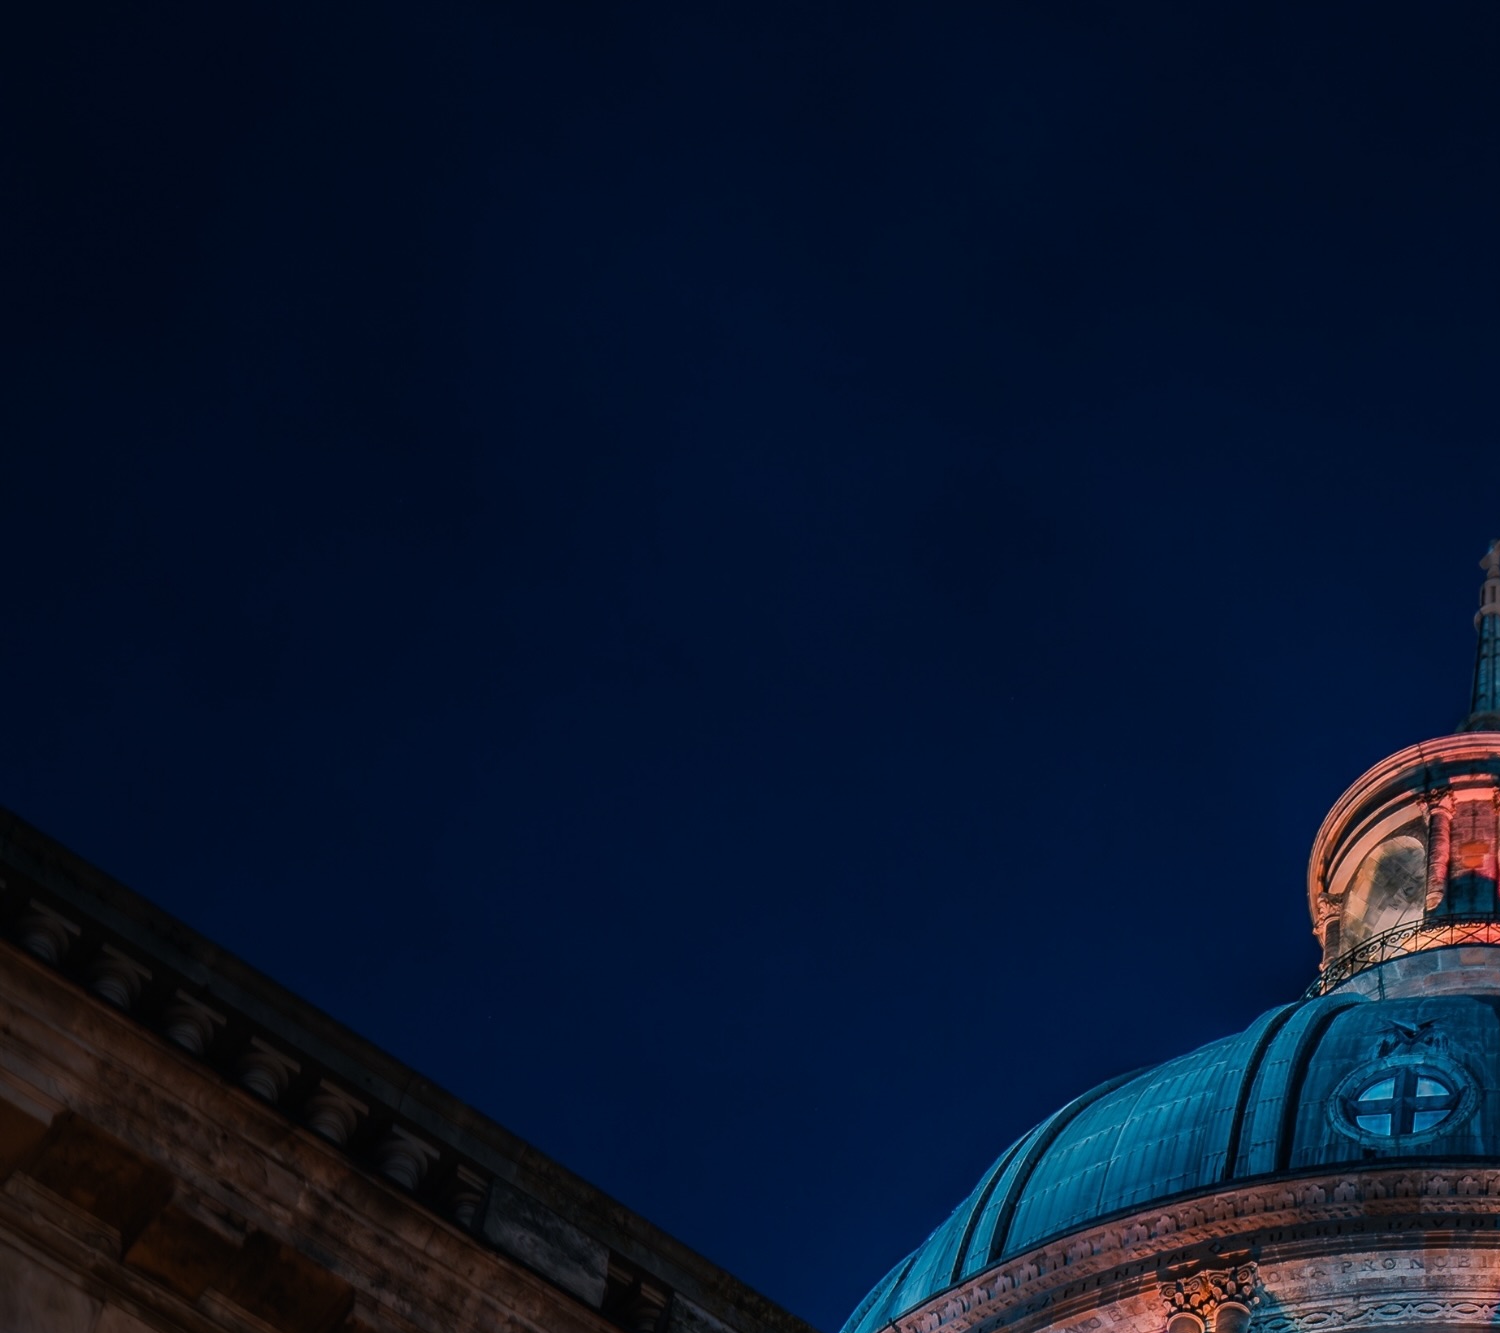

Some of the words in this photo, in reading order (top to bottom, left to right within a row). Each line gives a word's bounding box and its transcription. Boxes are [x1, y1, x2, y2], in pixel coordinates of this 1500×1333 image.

[1247, 1221, 1366, 1246] TURRIS
[1267, 1265, 1328, 1284] ORA
[1340, 1257, 1397, 1275] PRO
